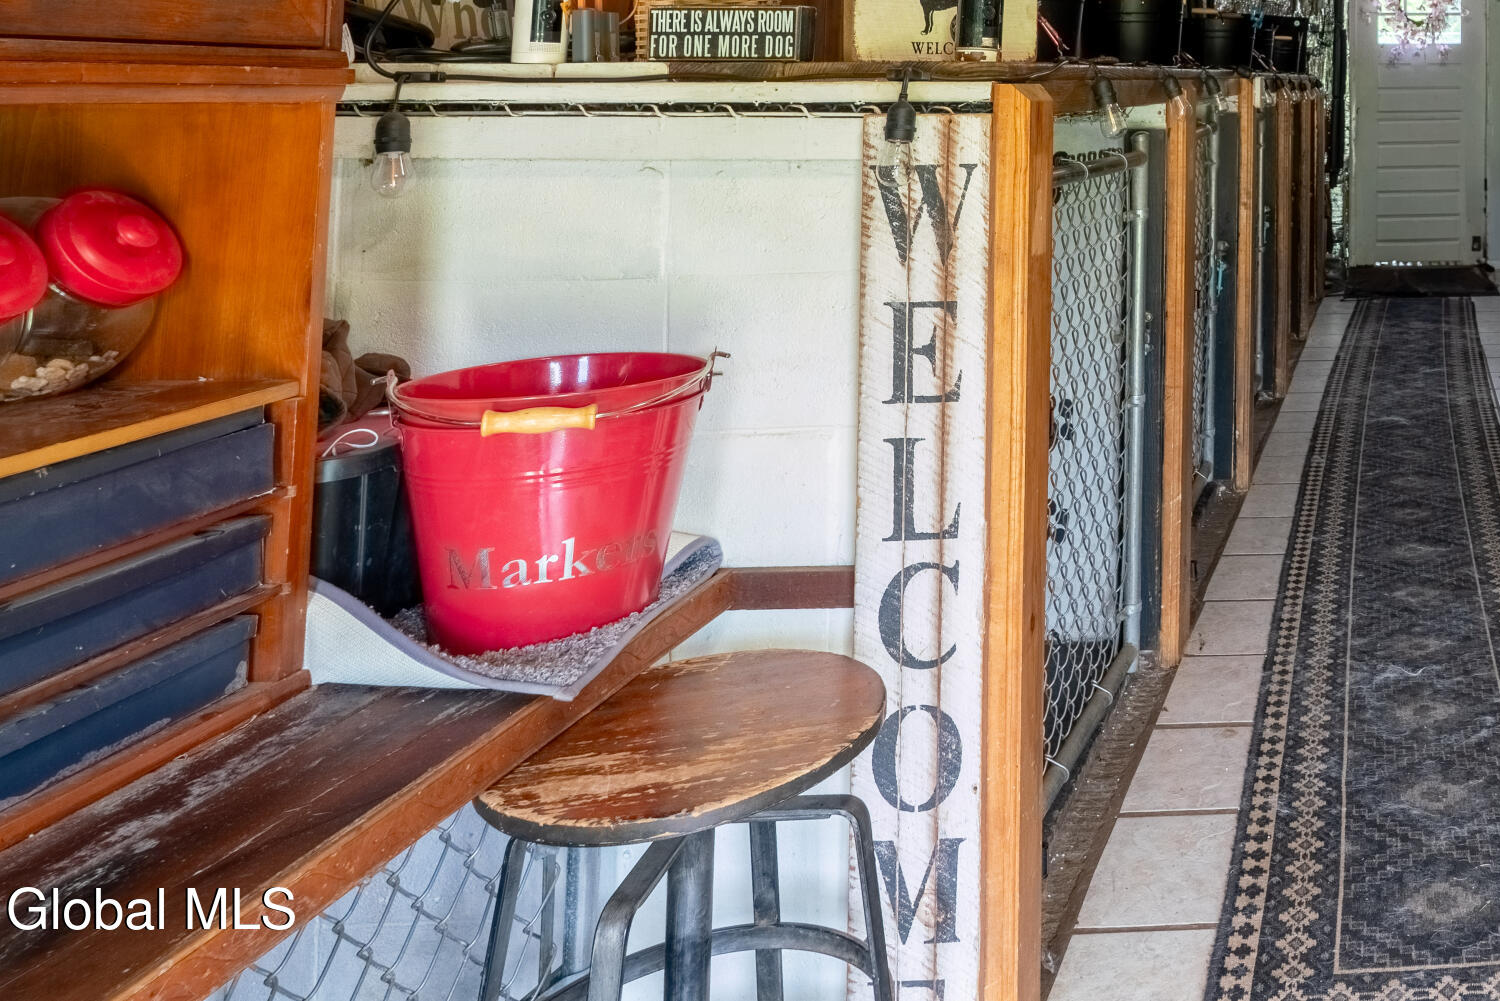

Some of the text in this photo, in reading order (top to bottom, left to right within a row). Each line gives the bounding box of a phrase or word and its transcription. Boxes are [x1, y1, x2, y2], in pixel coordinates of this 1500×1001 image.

[651, 9, 794, 33] THERE IS ALWAYS ROOM
[650, 34, 794, 58] FOR ONE MORE DOG
[911, 41, 954, 55] WELC
[868, 162, 978, 1001] WELCOM
